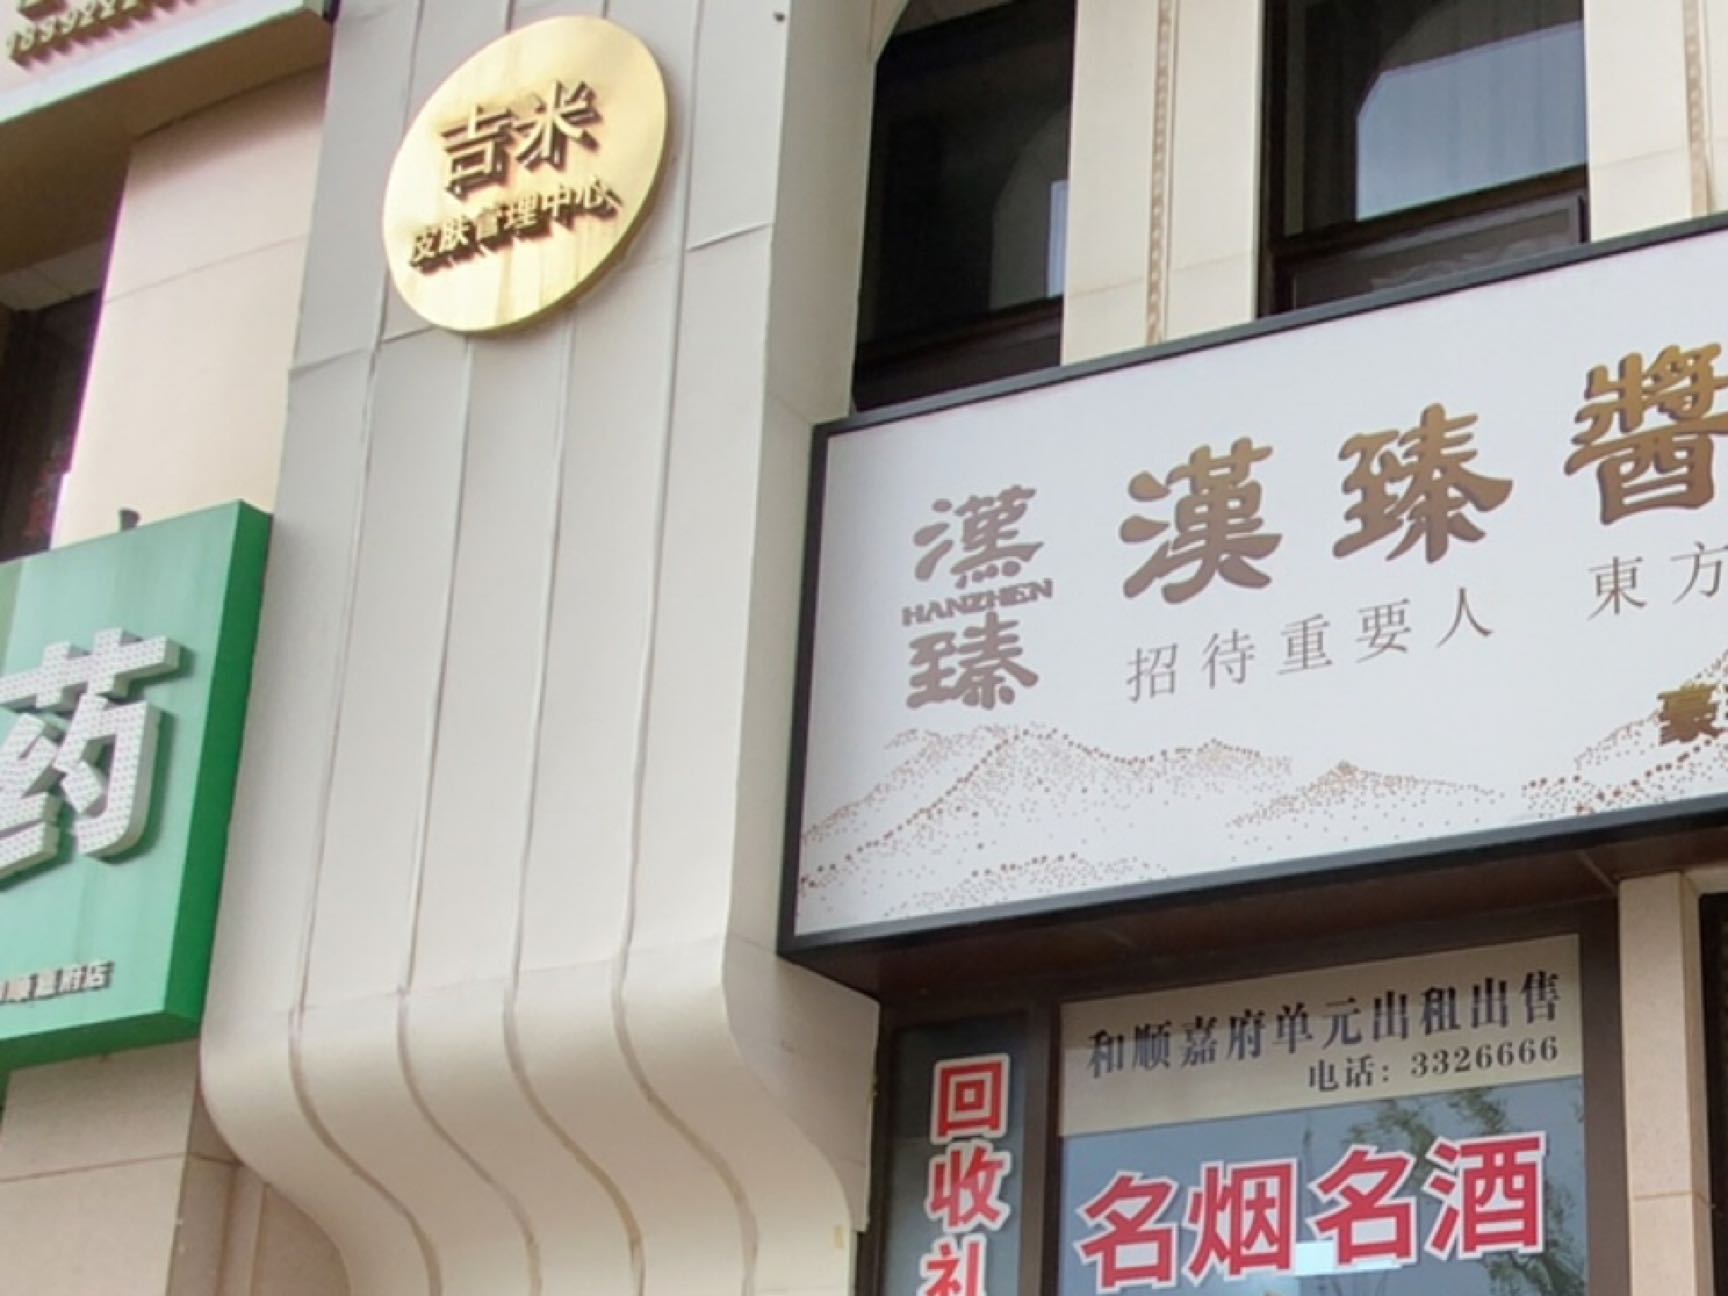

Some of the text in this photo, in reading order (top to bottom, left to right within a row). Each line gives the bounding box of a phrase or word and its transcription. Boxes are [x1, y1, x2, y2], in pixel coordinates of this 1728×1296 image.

[438, 78, 604, 202] 吉米
[900, 576, 1054, 627] HANZHEN
[1125, 586, 1494, 703] 招待重要人
[1085, 968, 1566, 1080] 和顺嘉府单元出租出售
[1074, 1128, 1548, 1296] 名烟名酒
